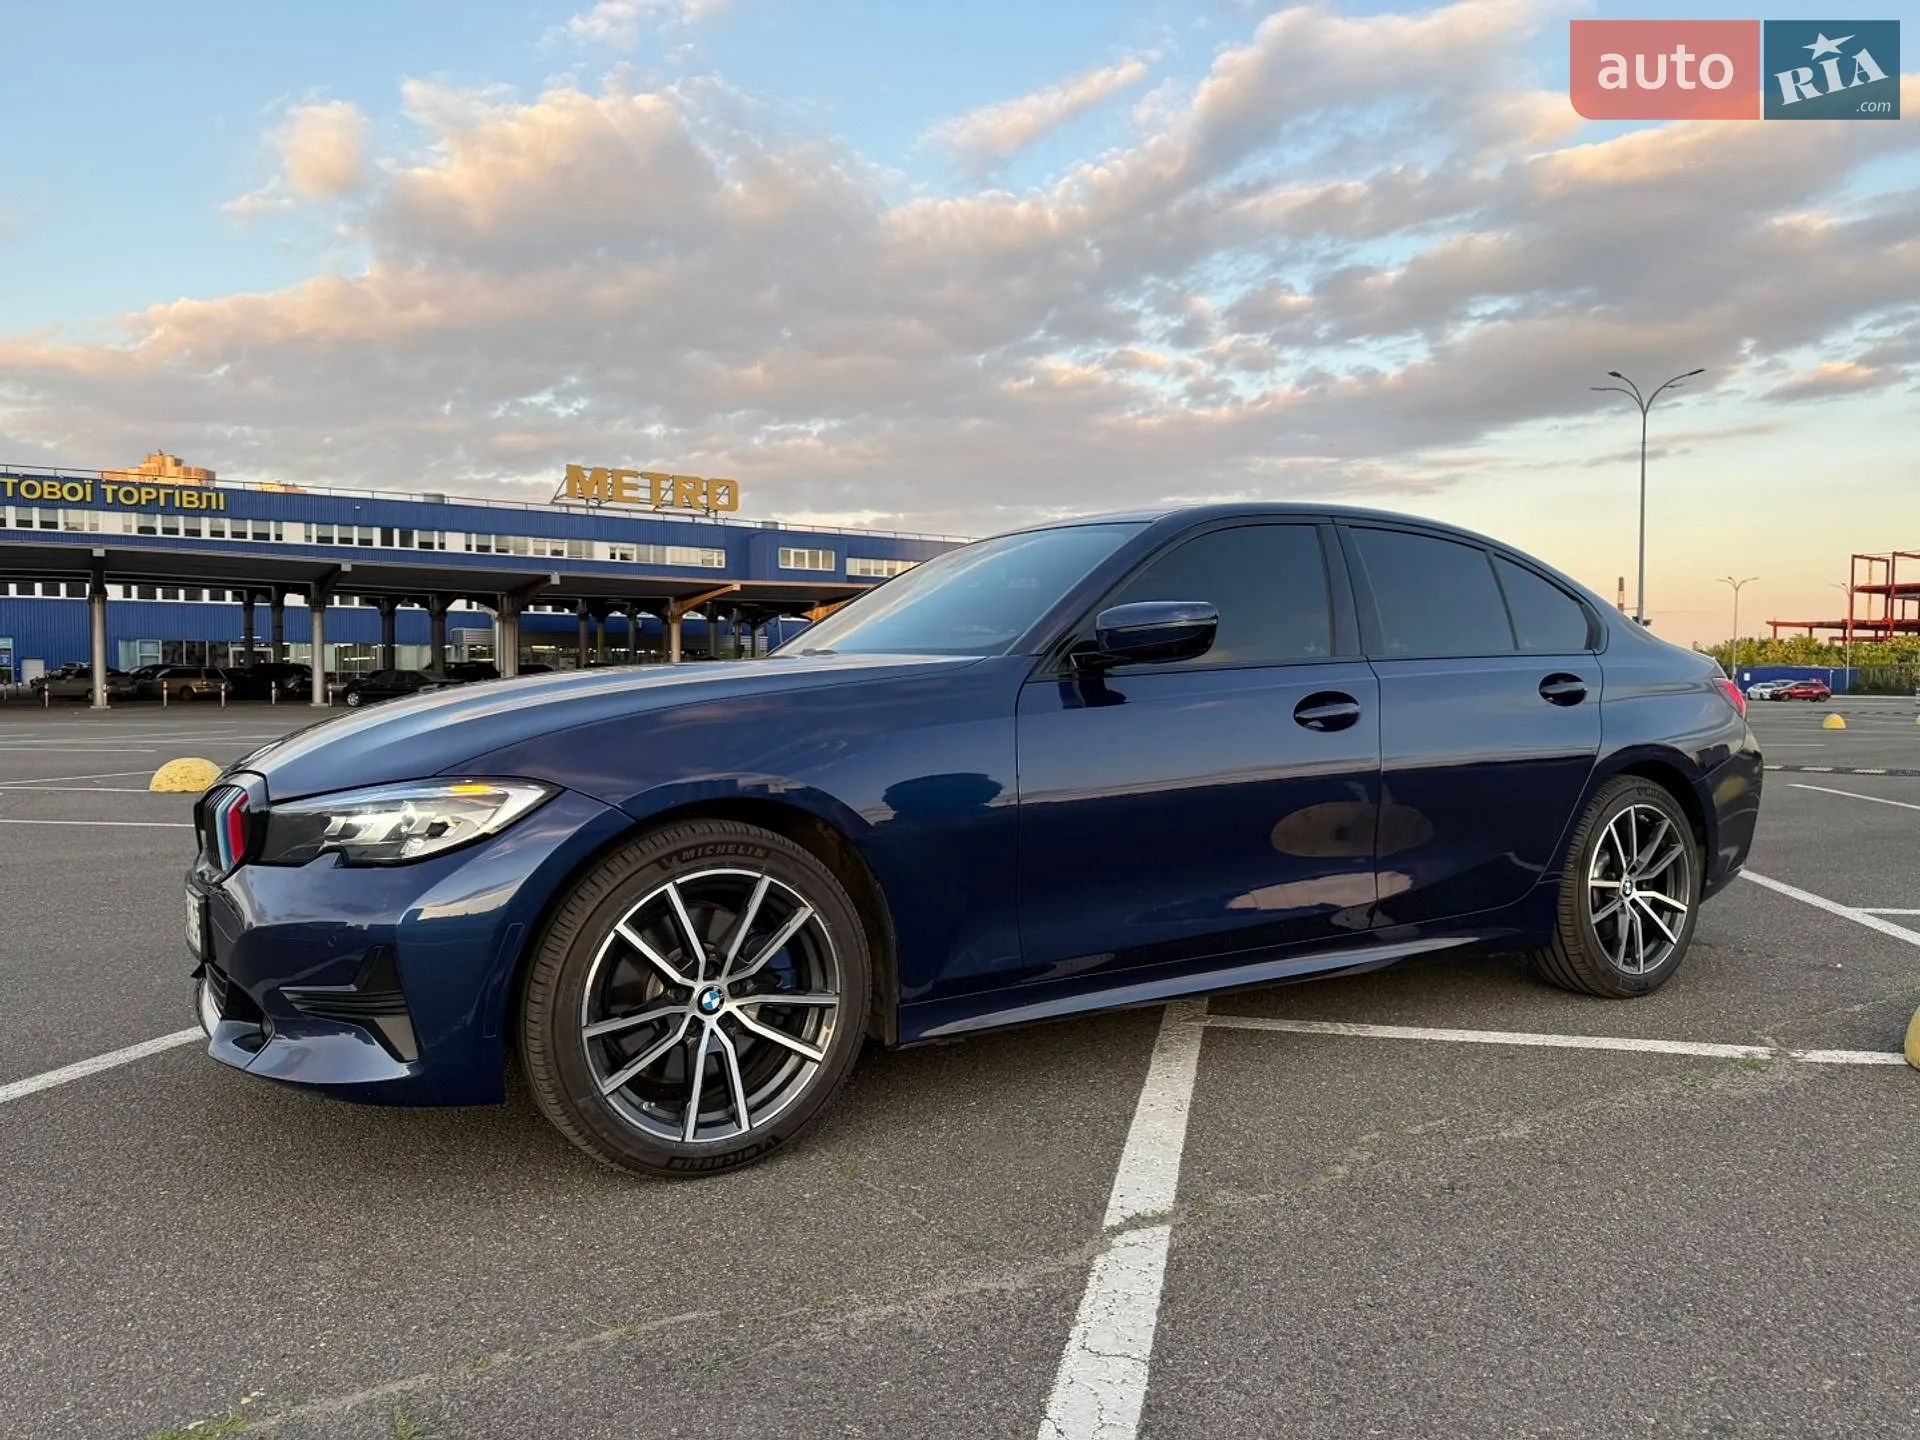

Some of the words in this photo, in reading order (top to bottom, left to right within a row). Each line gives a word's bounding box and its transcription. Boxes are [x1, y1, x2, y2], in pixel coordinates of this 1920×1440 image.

[0, 478, 93, 502] ТОВОЇ
[102, 485, 225, 511] ТОРГІВЛІ
[567, 464, 738, 512] METRO
[682, 844, 767, 861] MICHELIN
